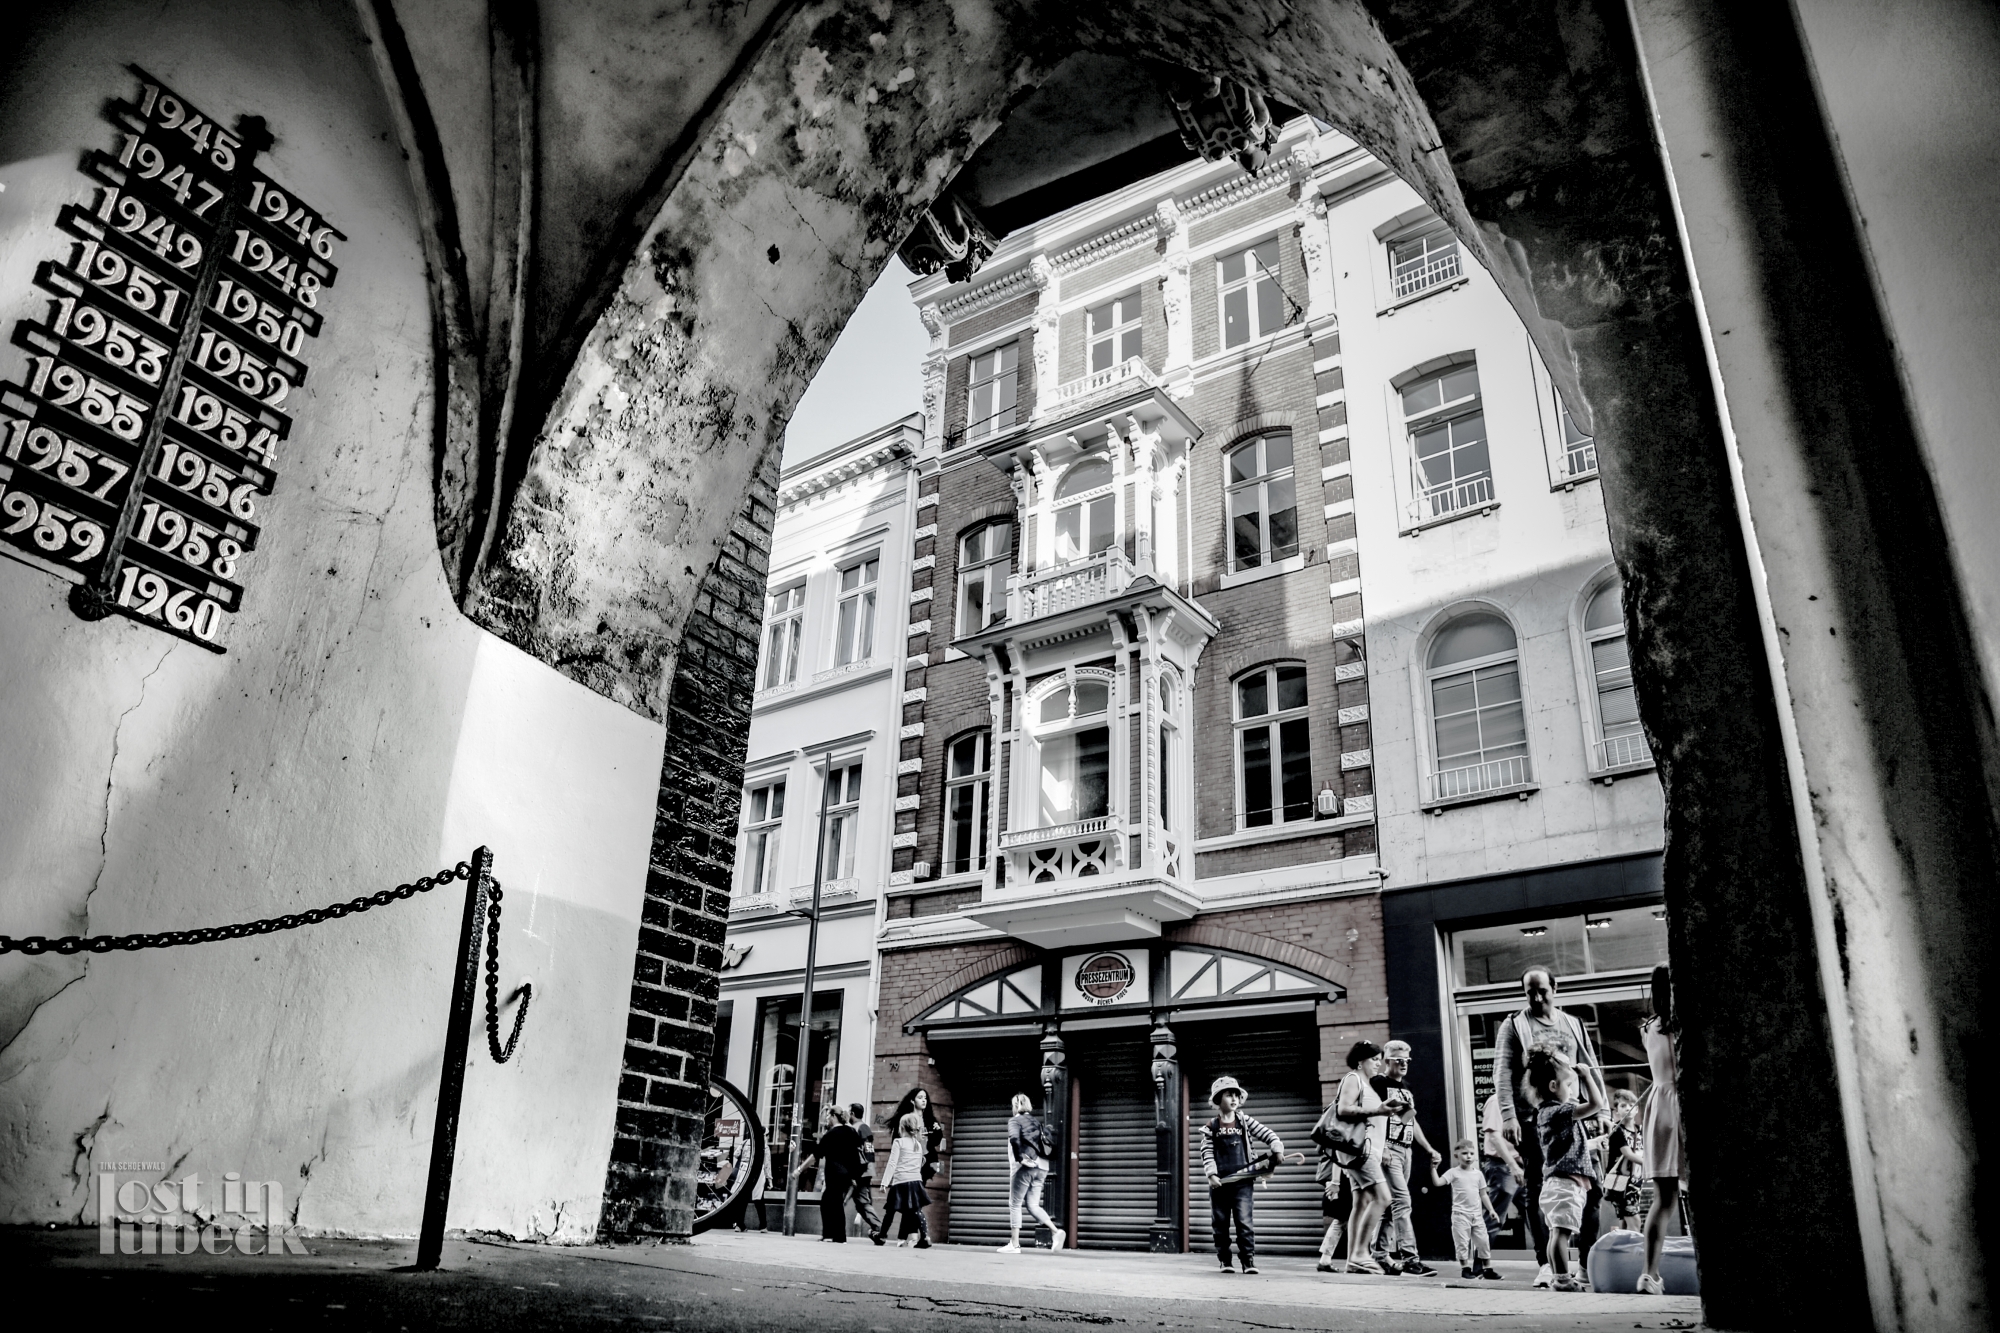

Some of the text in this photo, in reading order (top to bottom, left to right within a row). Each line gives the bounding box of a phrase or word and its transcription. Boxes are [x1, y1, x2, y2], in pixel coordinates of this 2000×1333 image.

[139, 83, 241, 171] 1945
[117, 133, 224, 219] 1947
[97, 187, 203, 270] 1949
[250, 181, 334, 261] 1946
[72, 241, 181, 327] 1951
[232, 229, 321, 309] 1948
[50, 297, 169, 382] 1953
[215, 281, 306, 359] 1950
[28, 355, 150, 441] 1955
[198, 332, 290, 412] 1952
[3, 420, 129, 501] 1957
[179, 385, 279, 470] 1954
[159, 442, 257, 521] 1956
[0, 485, 106, 563] 959
[138, 503, 242, 580] 1958
[118, 567, 222, 641] 1960
[1080, 969, 1129, 984] PRESSEZENTRUM
[1082, 992, 1094, 1003] MUSIK
[1116, 989, 1128, 1000] VIDEO
[889, 1062, 900, 1073] 79
